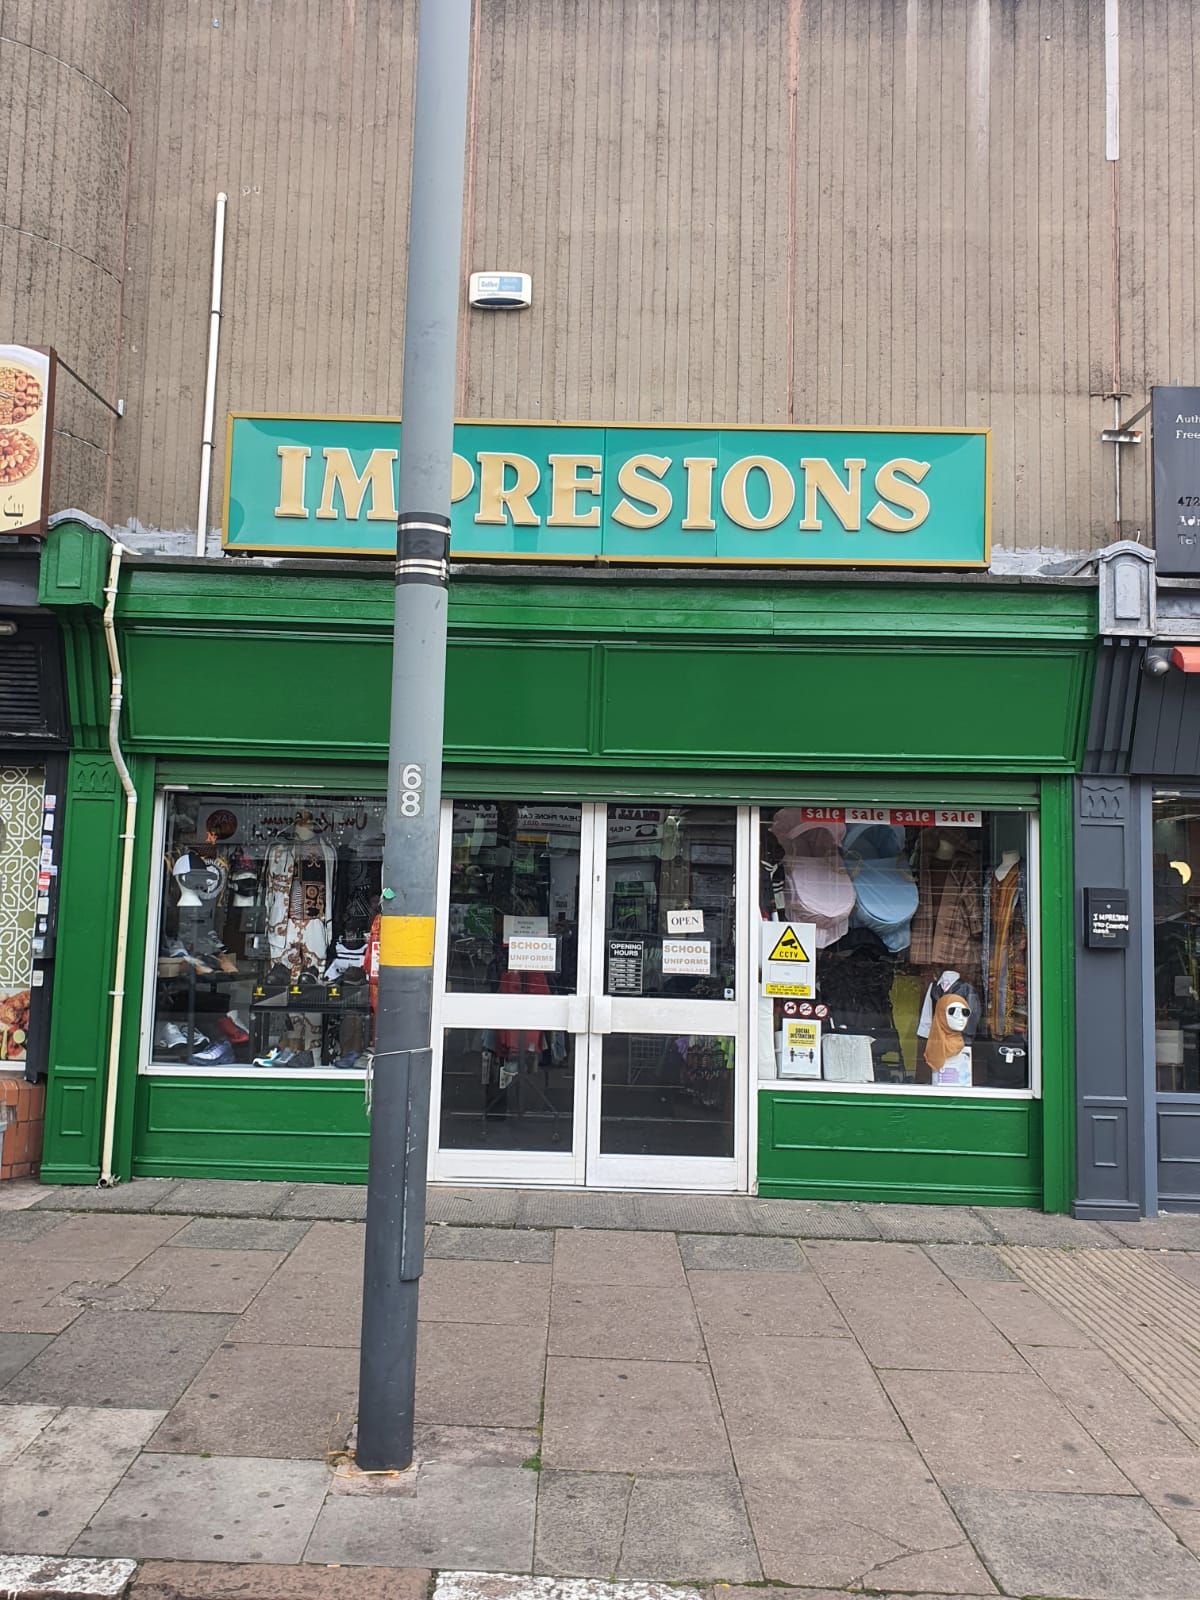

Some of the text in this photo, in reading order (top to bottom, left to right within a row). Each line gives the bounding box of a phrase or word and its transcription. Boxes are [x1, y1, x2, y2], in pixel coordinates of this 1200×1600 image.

[806, 807, 840, 819] sale
[852, 808, 884, 820] sale
[895, 809, 929, 822] sale
[941, 810, 975, 822] sale
[670, 916, 700, 926] OPEN
[510, 941, 554, 951] SCHOOL
[610, 943, 642, 952] OPENING
[663, 944, 709, 954] SCHOOL
[509, 954, 554, 962] UNIFORMS
[613, 949, 639, 957] HOURS
[779, 951, 799, 959] CCTV
[663, 957, 709, 965] UNIFORMS
